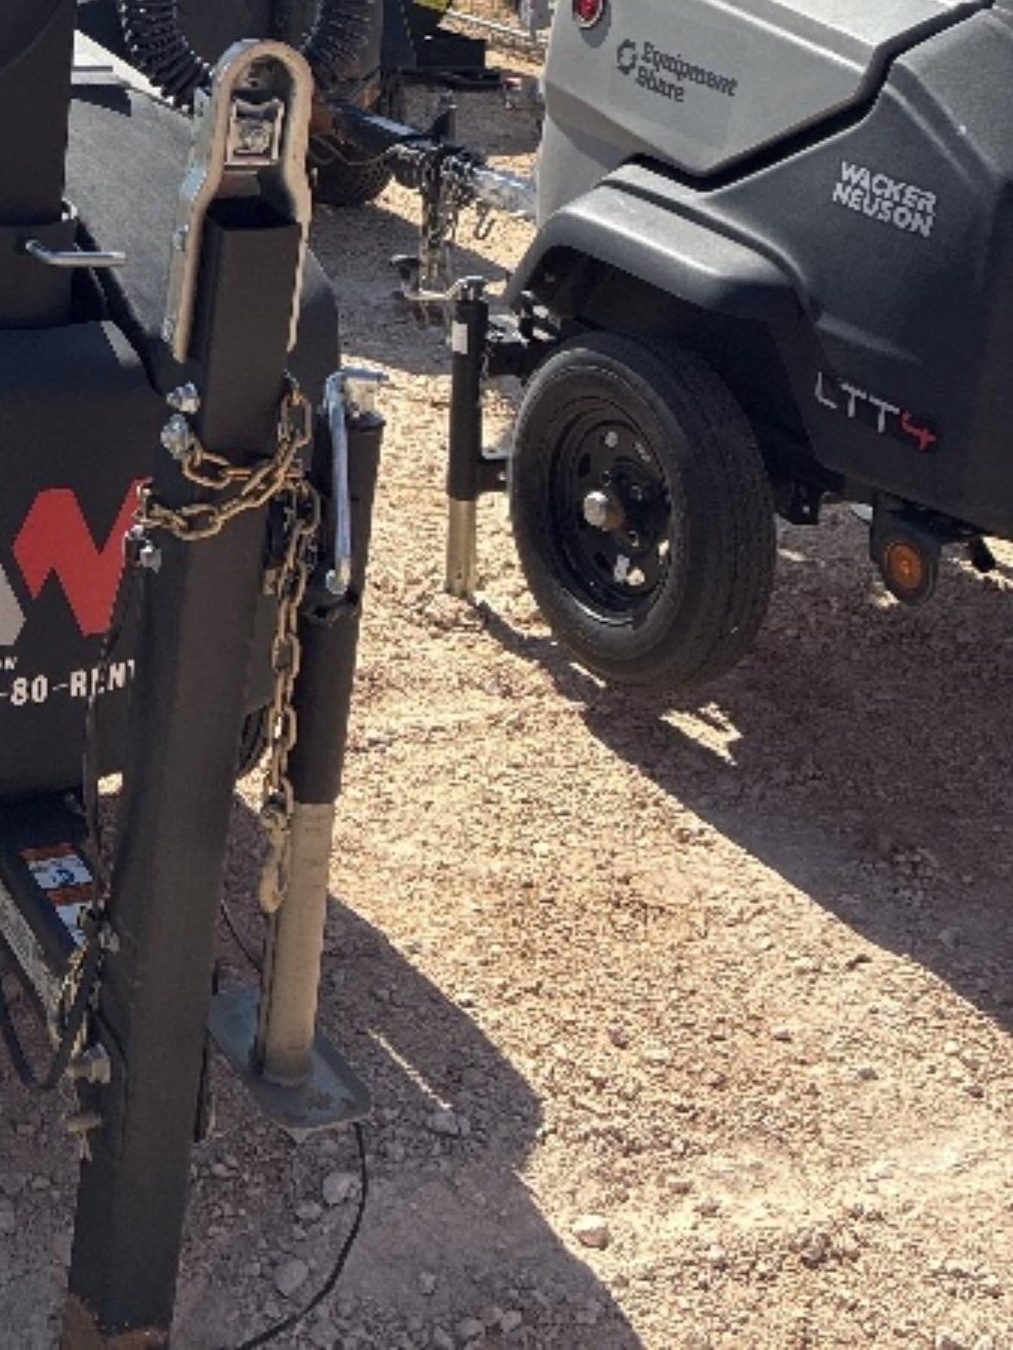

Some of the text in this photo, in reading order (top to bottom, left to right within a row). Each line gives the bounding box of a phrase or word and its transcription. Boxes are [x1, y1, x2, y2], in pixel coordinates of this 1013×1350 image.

[832, 181, 937, 239] NEUSON
[840, 160, 937, 216] WACKER
[814, 371, 938, 452] LTT4
